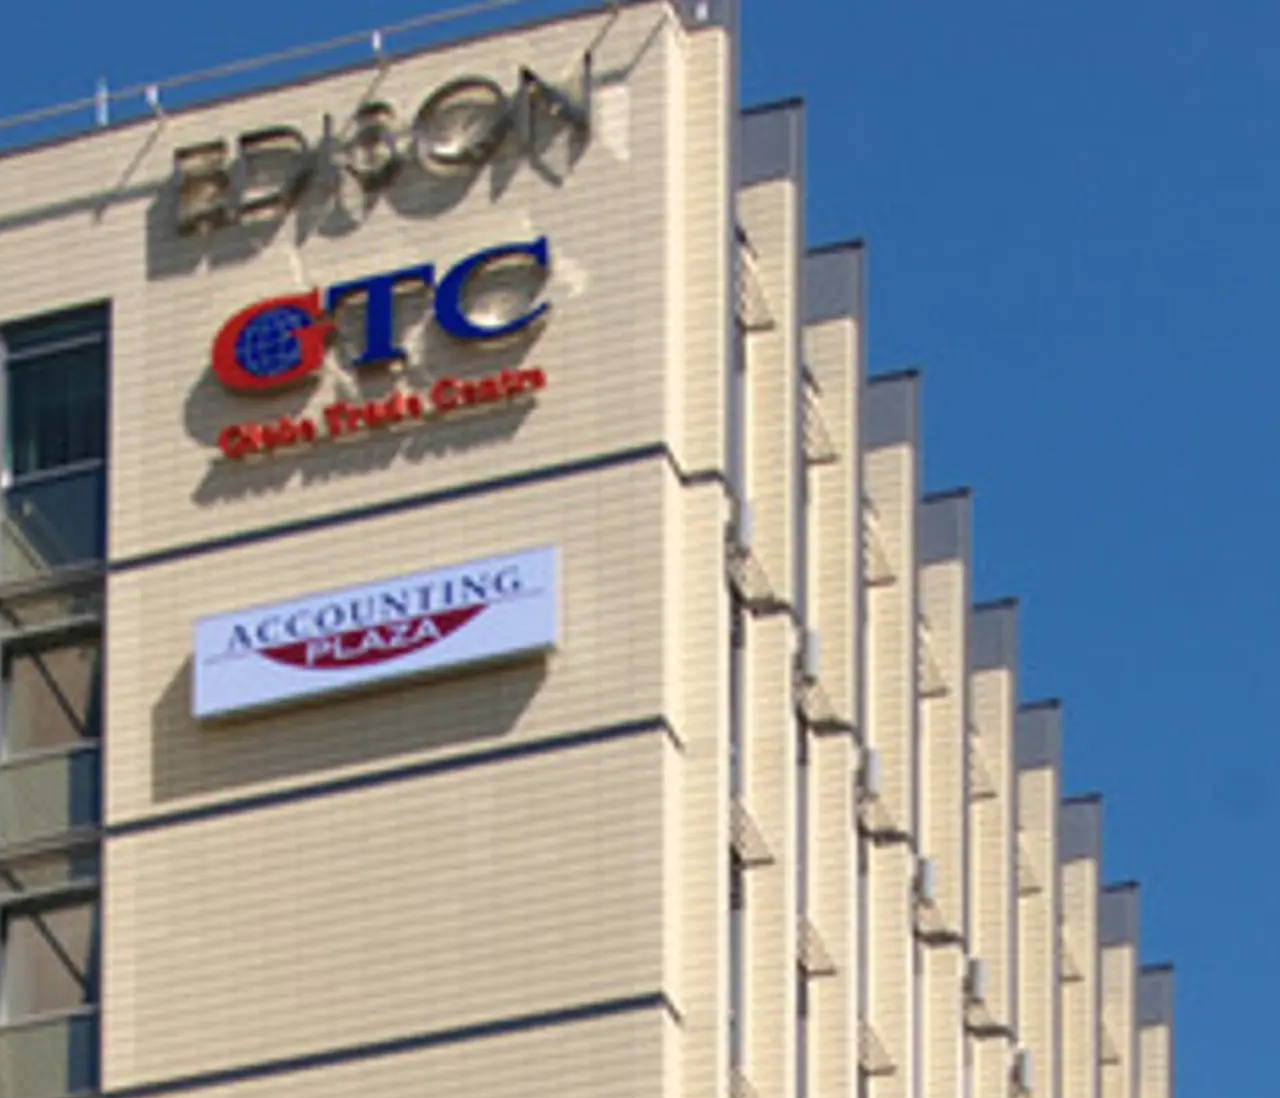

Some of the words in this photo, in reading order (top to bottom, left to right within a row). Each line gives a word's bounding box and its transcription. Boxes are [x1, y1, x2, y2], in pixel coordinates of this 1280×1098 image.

[174, 50, 592, 236] EDISON
[211, 235, 551, 390] GTC
[218, 418, 315, 459] Globe
[323, 391, 422, 436] Trade
[431, 368, 545, 407] Centre
[227, 563, 522, 653] ACCOUNTING
[305, 617, 442, 667] PLAZA
